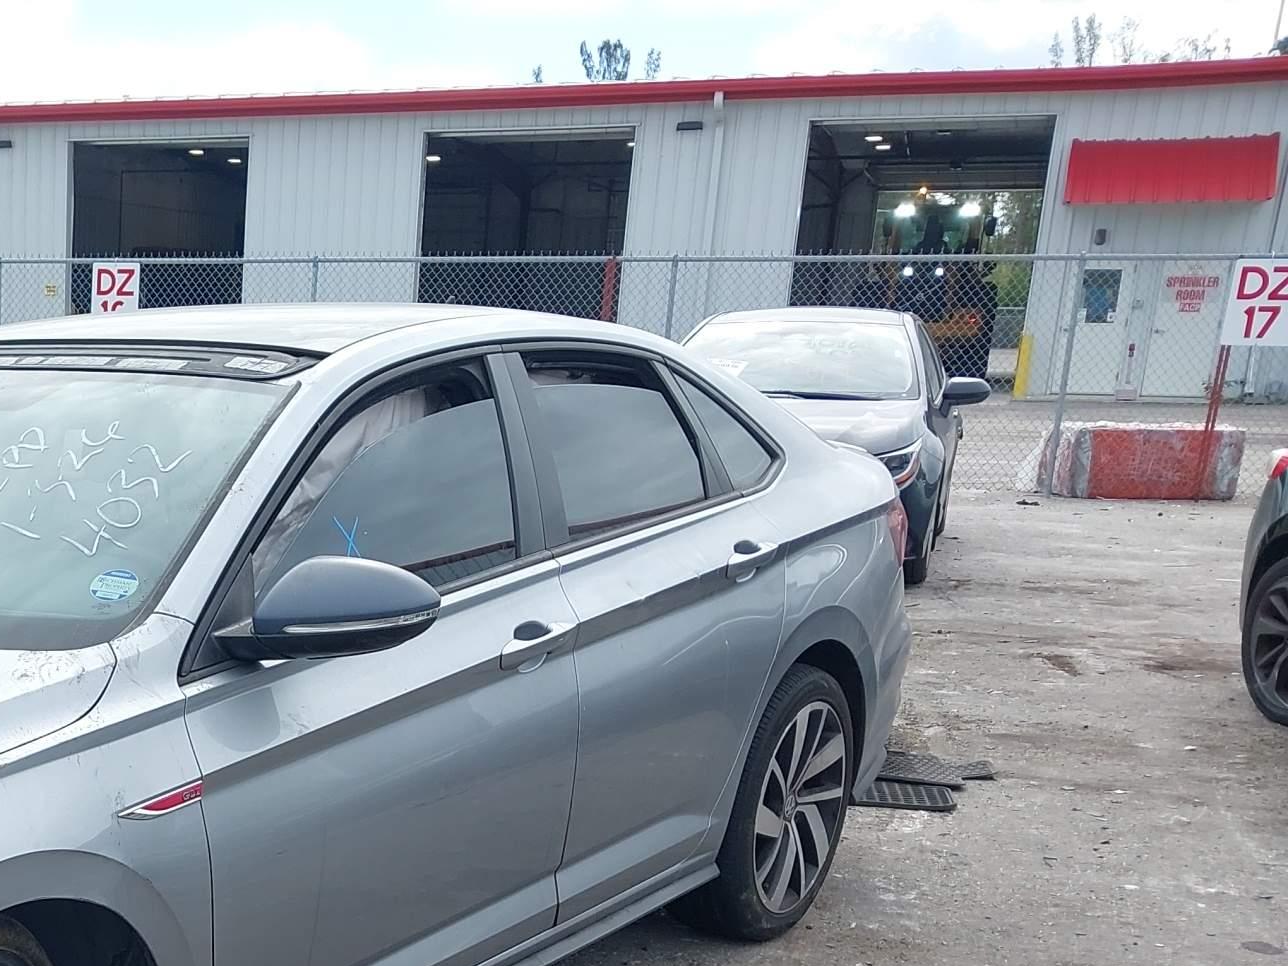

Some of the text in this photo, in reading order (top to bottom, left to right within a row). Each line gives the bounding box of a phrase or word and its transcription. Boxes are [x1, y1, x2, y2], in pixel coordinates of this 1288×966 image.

[96, 268, 135, 297] DZ
[1166, 276, 1220, 288] SPRINKLER
[1175, 289, 1207, 301] ROOM
[1236, 265, 1288, 301] DZ
[1243, 305, 1282, 339] 17
[60, 443, 193, 557] 4032
